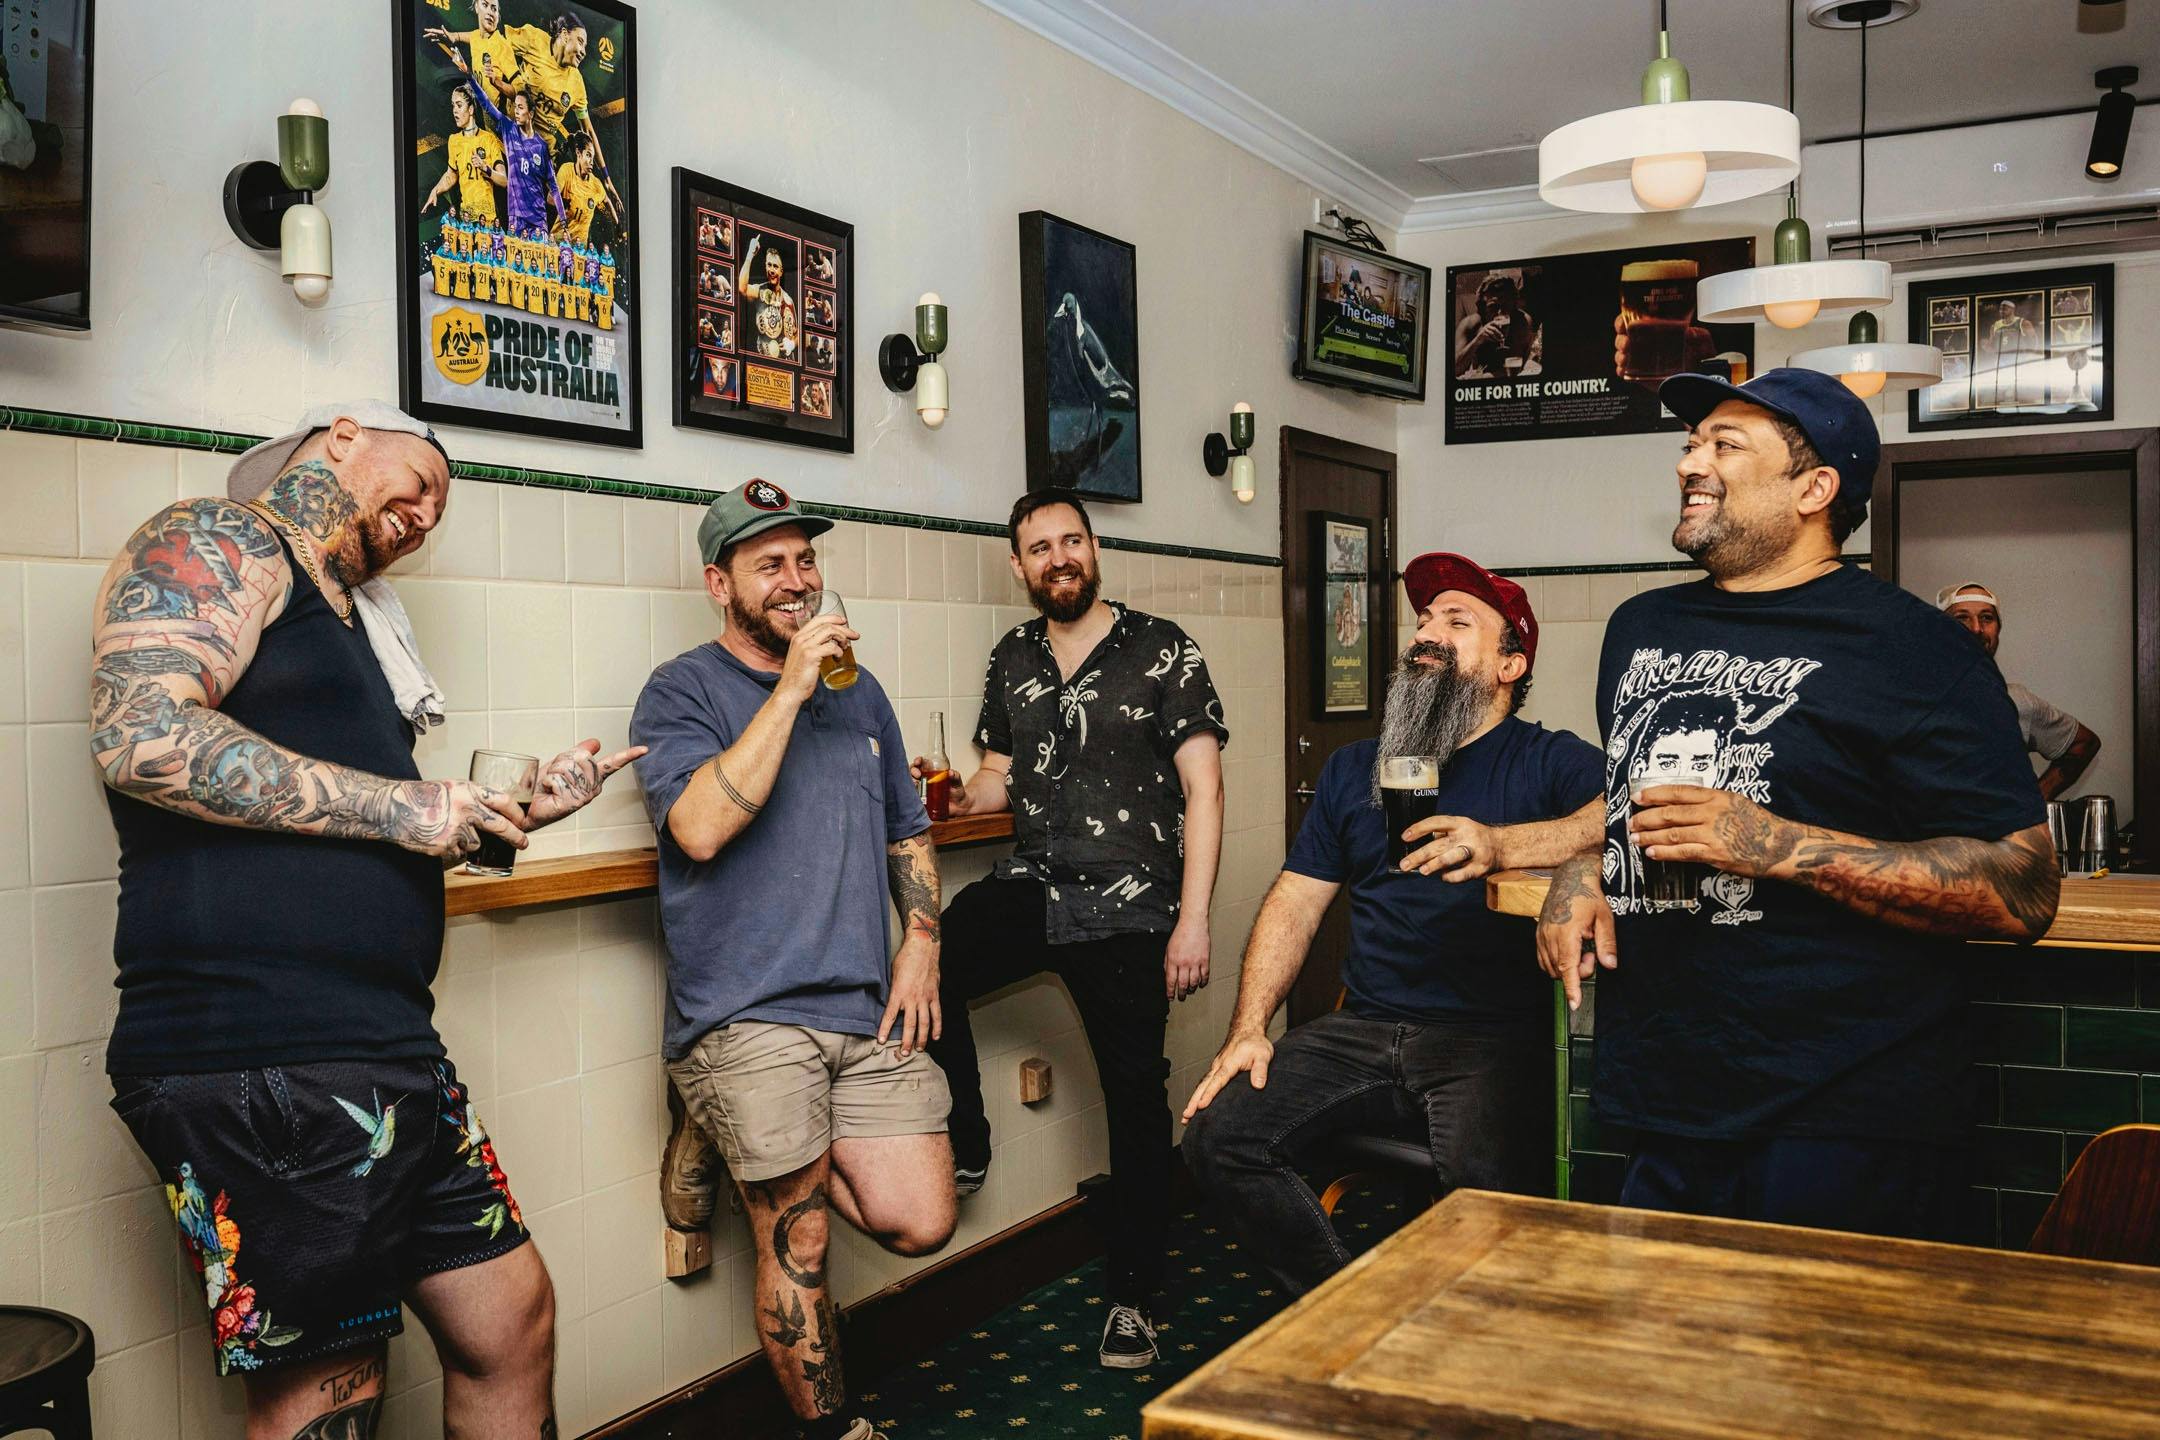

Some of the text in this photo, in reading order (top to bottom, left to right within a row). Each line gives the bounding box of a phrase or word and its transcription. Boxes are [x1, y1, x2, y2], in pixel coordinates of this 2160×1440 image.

[520, 157, 530, 175] 18
[575, 207, 583, 222] 11
[524, 249, 532, 260] 23
[439, 266, 445, 279] 5
[459, 271, 467, 284] 13
[479, 272, 487, 284] 21
[500, 276, 506, 288] 9
[515, 281, 521, 291] 7
[531, 286, 540, 297] 20
[550, 291, 557, 302] 19
[567, 293, 572, 305] 8
[602, 303, 607, 315] 6
[1341, 302, 1396, 328] The Castle
[485, 313, 593, 367] PRIDE OF
[448, 358, 480, 366] AUSTRALIA
[485, 352, 620, 407] AUSTRALIA
[1454, 378, 1610, 402] ONE FOR THE COUNTRY.
[1614, 654, 1682, 712] KING
[1729, 743, 1774, 768] KING
[1737, 765, 1760, 784] AD
